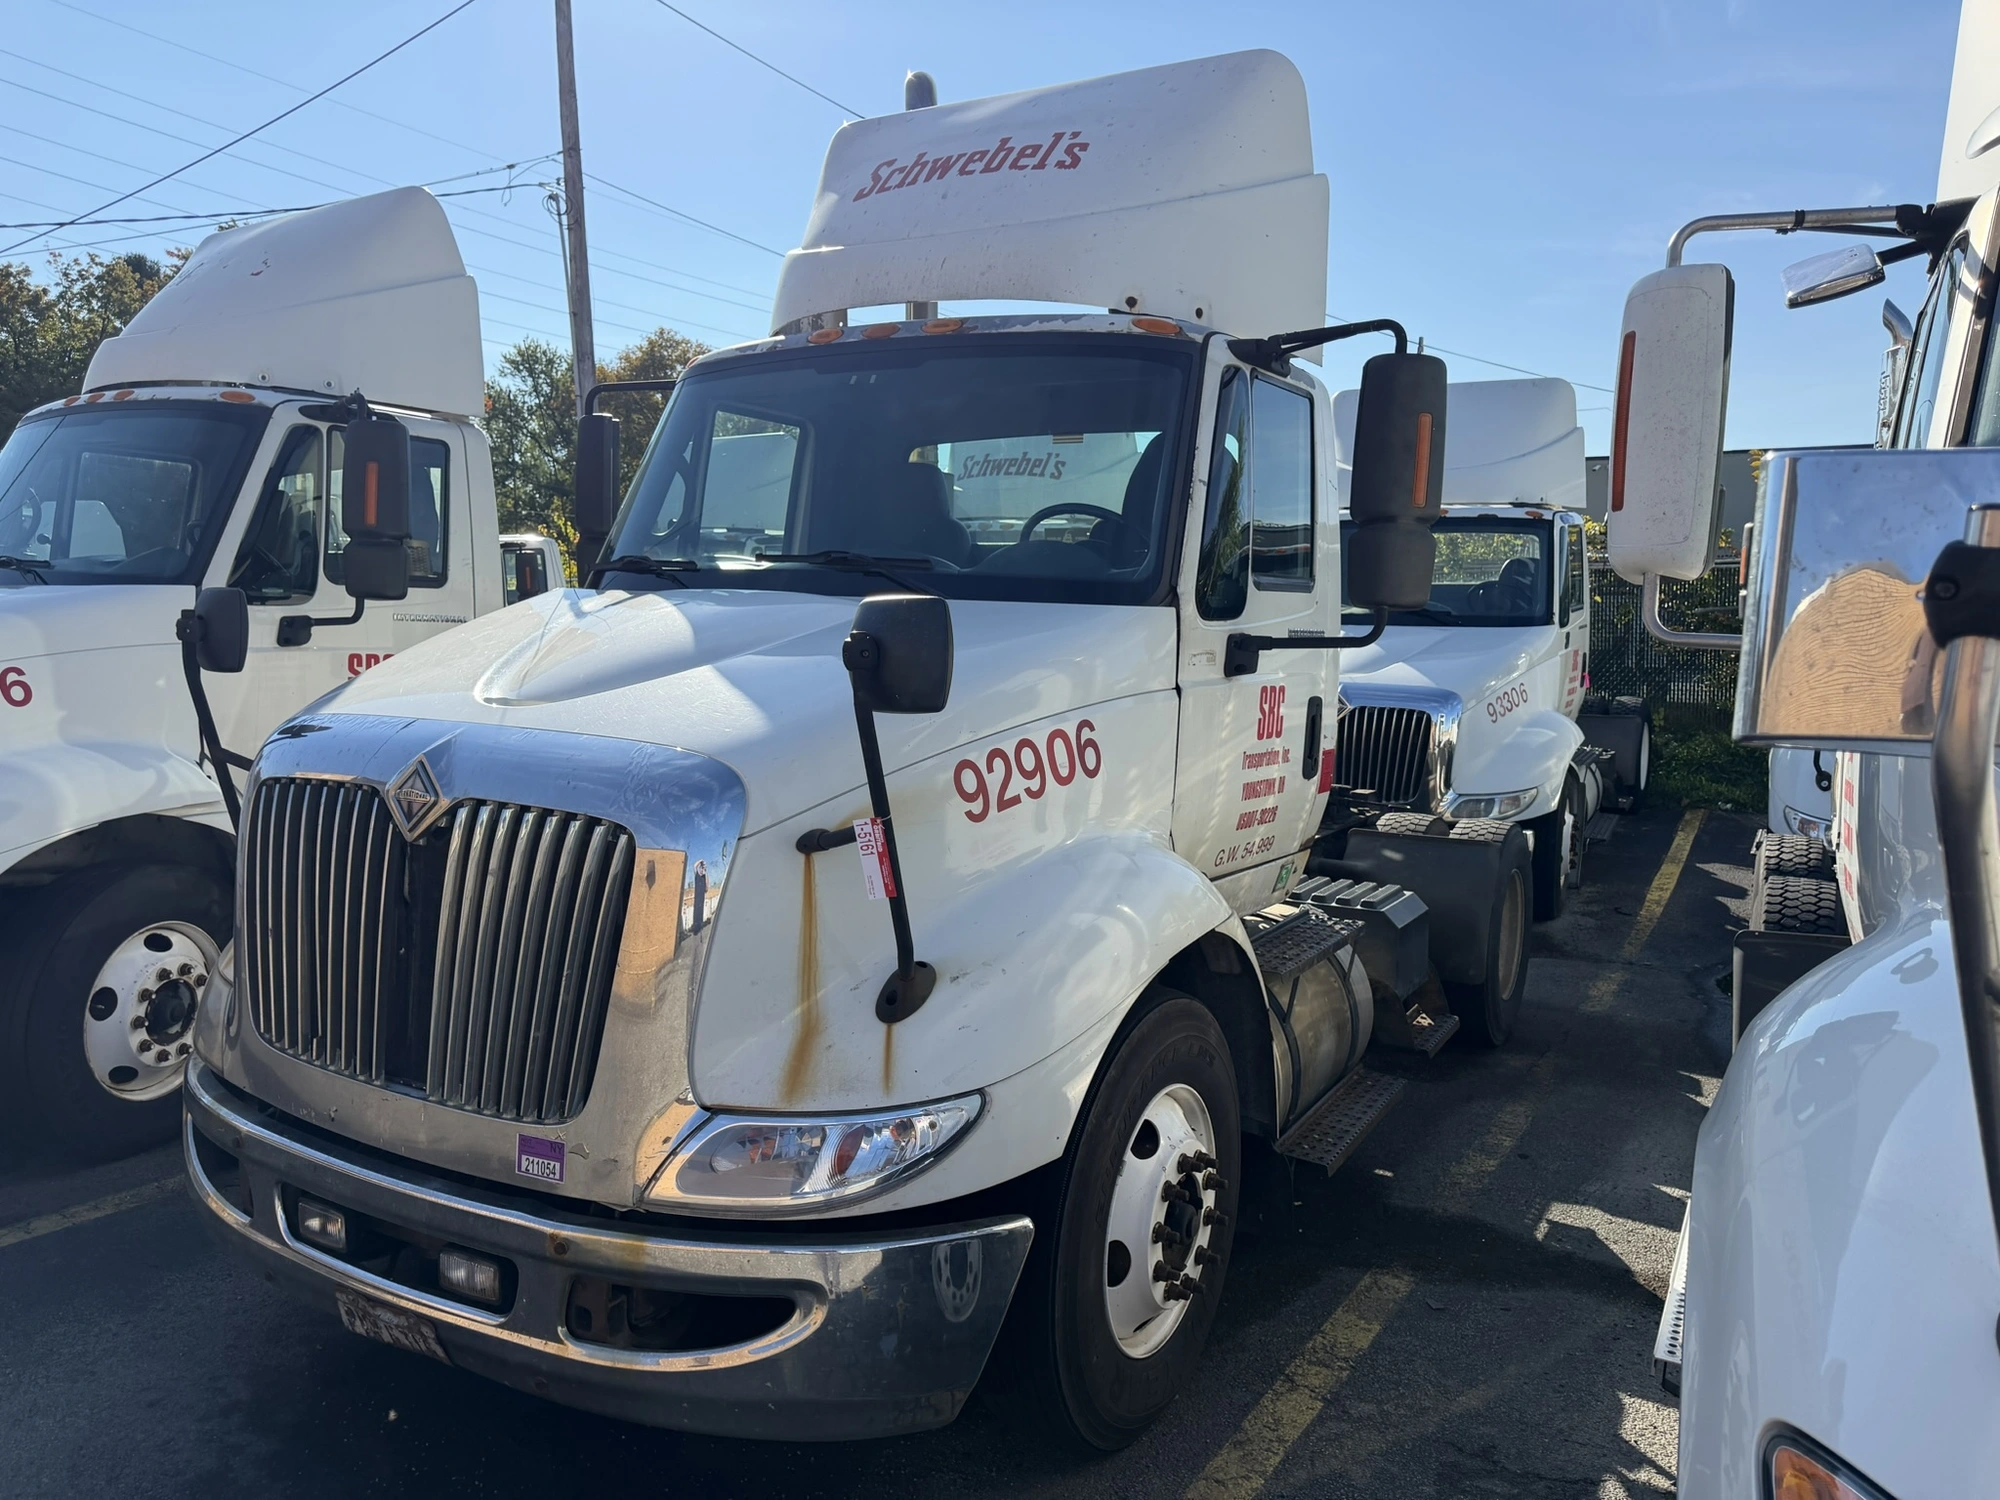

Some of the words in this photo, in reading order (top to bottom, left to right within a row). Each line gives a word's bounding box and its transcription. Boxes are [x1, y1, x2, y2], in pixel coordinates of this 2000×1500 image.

[852, 130, 1090, 203] Schwebel's
[956, 451, 1067, 481] Schwebel's
[1256, 684, 1286, 741] SBC
[1486, 682, 1529, 724] 93306
[953, 718, 1102, 824] 92906
[855, 821, 876, 857] 1-5161
[1214, 844, 1241, 867] G.W.
[1241, 835, 1276, 859] 54,999
[524, 1157, 557, 1178] 211054
